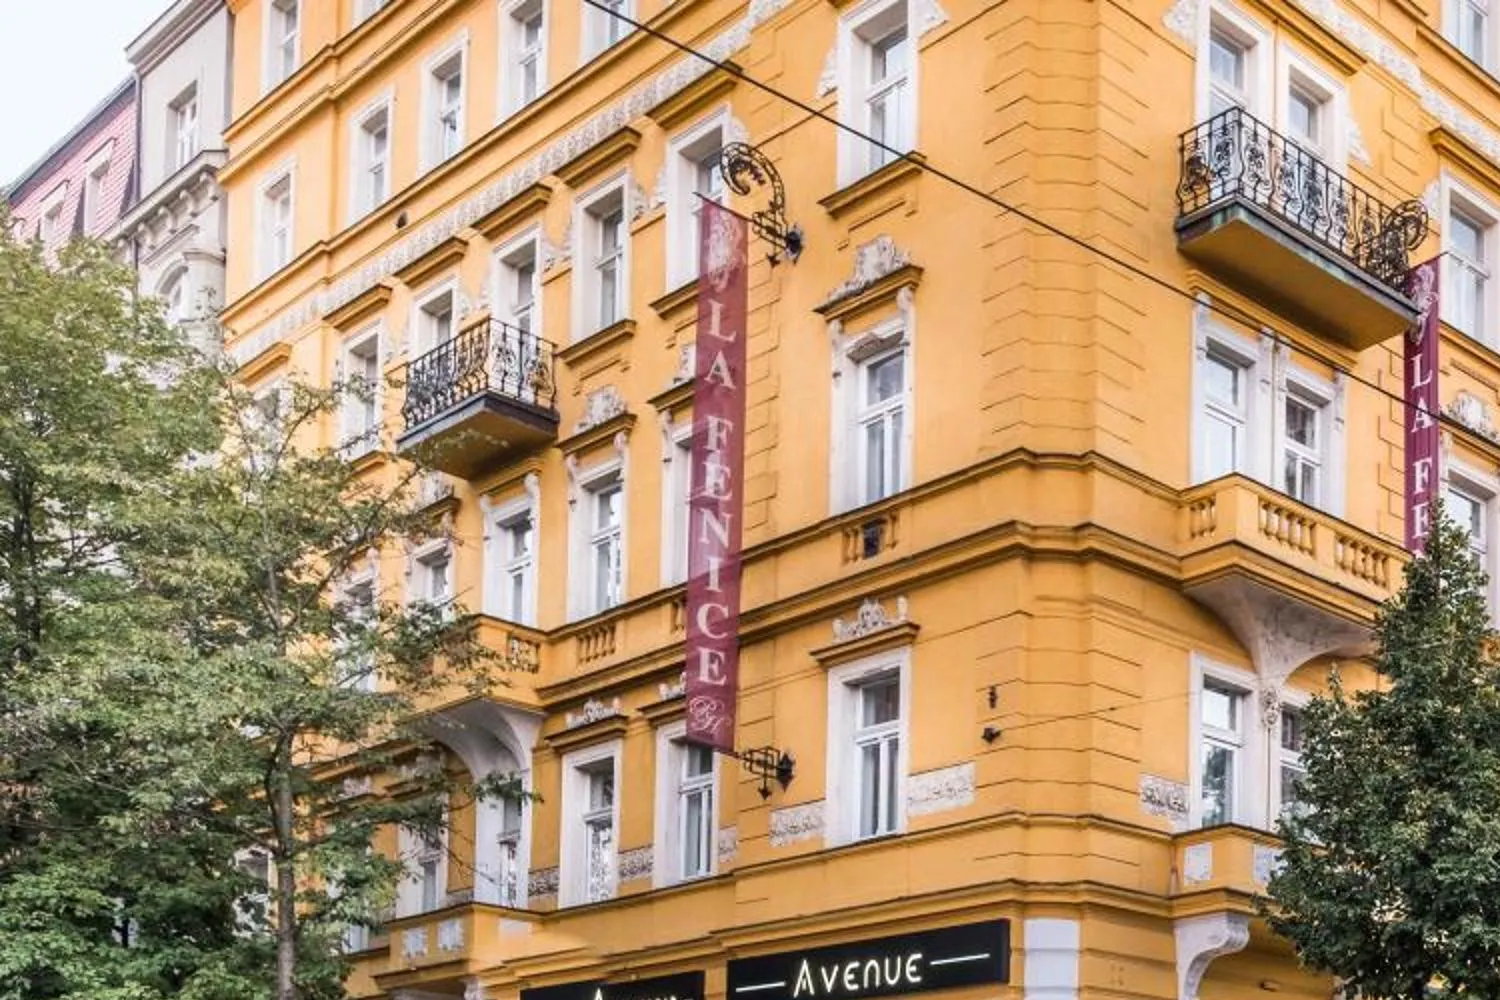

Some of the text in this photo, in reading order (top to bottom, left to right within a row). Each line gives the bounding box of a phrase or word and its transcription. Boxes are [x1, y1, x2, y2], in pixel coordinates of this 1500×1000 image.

[1411, 354, 1436, 433] LA
[696, 299, 736, 686] LA FENICE
[793, 953, 924, 998] AVENUE
